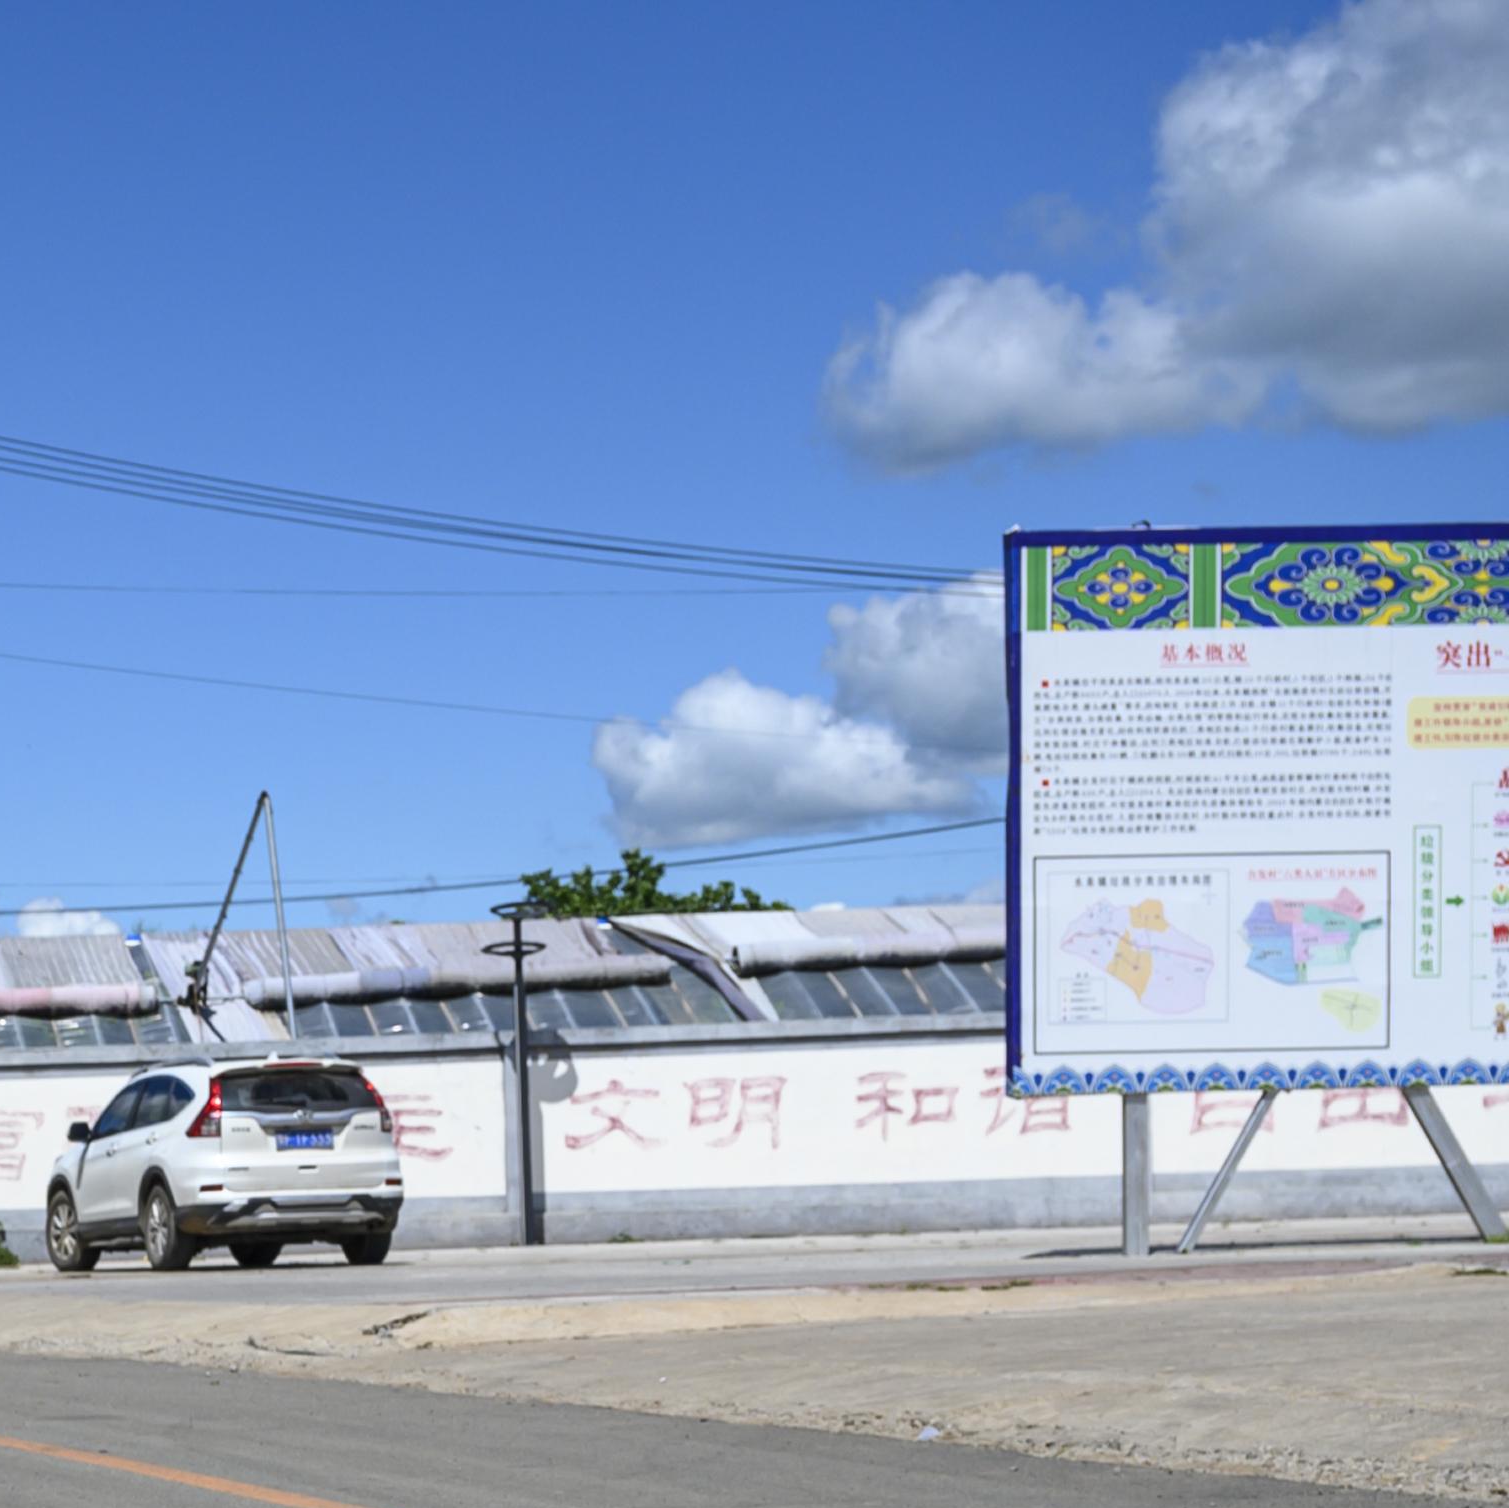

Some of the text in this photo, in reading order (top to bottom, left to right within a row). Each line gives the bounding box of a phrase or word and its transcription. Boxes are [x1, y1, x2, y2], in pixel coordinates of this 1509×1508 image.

[1162, 642, 1248, 662] 基本概况
[565, 1076, 788, 1150] 文明
